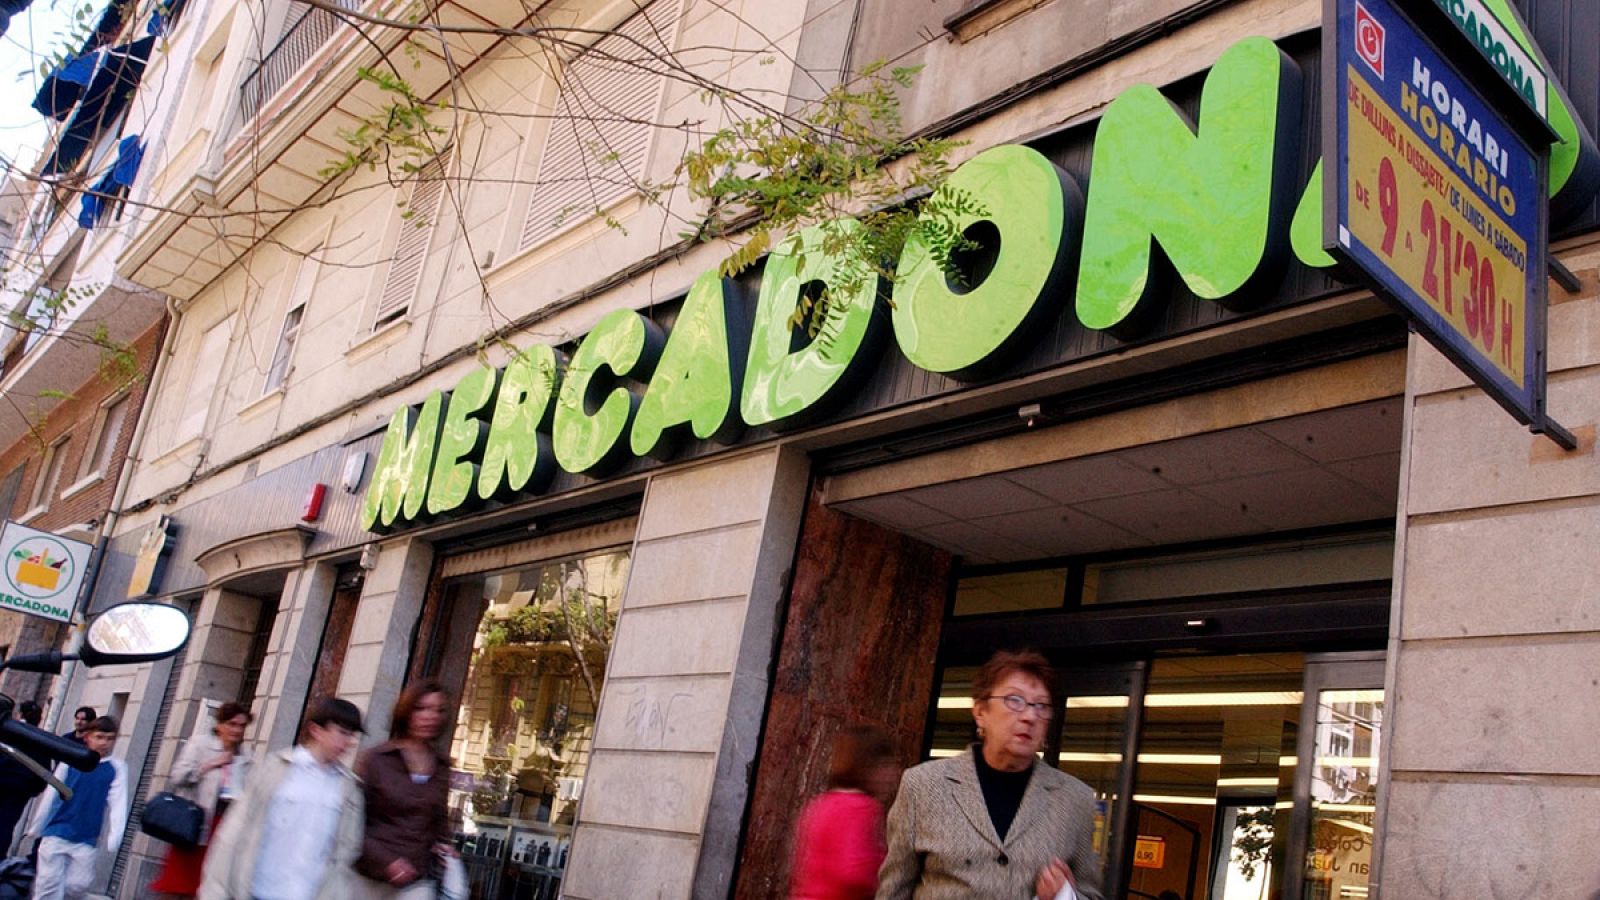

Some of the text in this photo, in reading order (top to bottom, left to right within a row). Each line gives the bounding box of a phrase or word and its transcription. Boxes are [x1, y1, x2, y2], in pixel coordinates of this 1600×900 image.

[1348, 78, 1360, 109] DE
[1361, 93, 1397, 152] DILLUNS
[1398, 134, 1405, 157] A
[1450, 185, 1460, 214] DE
[1462, 197, 1486, 240] LUNES
[1487, 222, 1493, 244] A
[1401, 80, 1516, 217] HORARIO
[1413, 56, 1509, 178] HORARI
[1355, 179, 1370, 211] DE
[1378, 156, 1398, 259] 9
[1405, 231, 1413, 253] A
[1420, 199, 1496, 353] 21'30
[0, 592, 69, 619] ERCADONA
